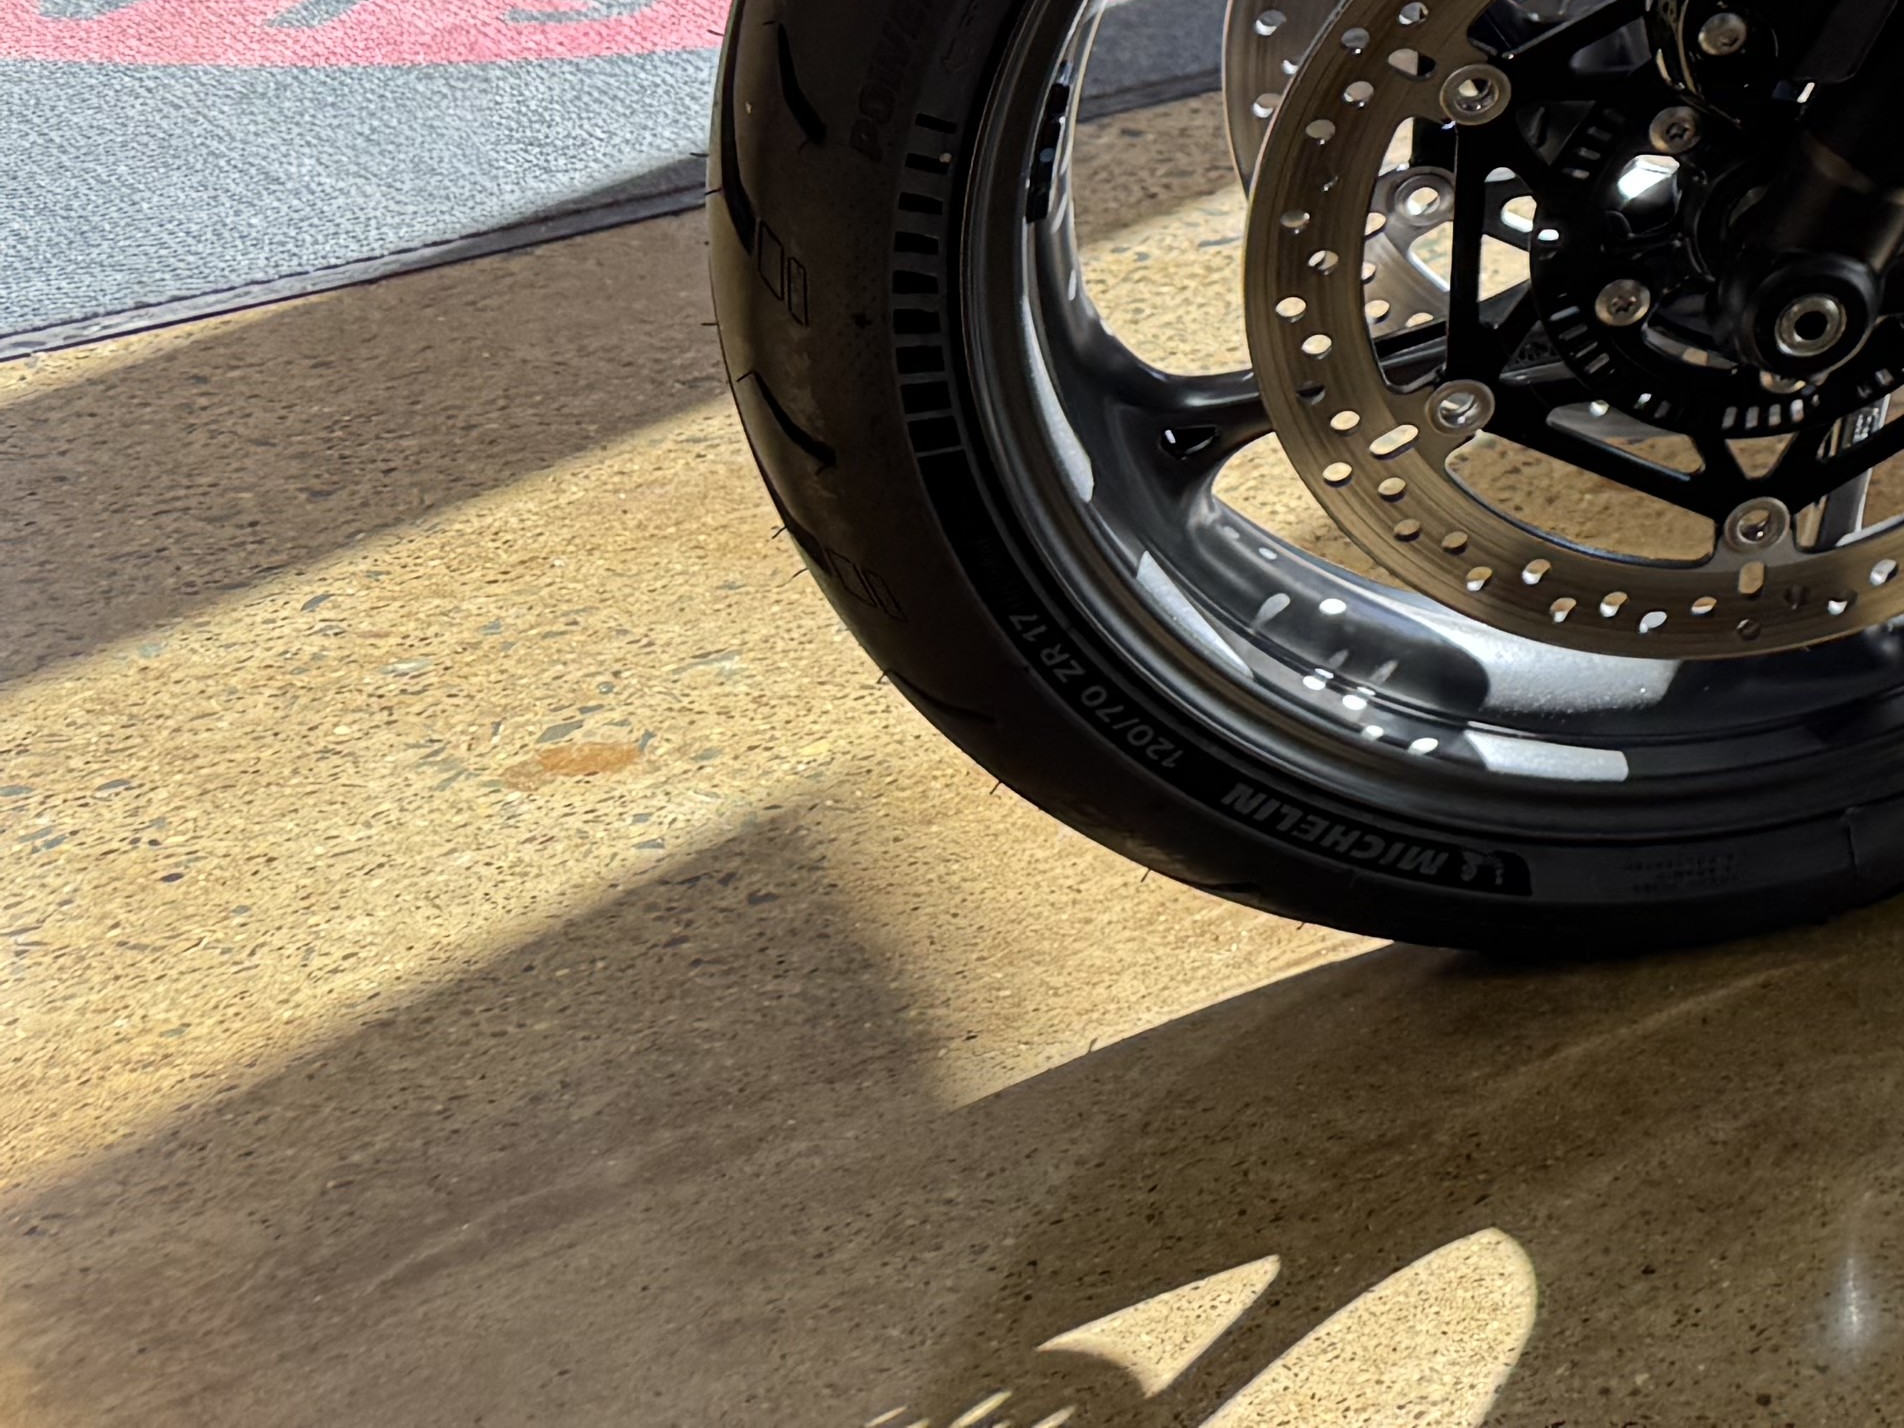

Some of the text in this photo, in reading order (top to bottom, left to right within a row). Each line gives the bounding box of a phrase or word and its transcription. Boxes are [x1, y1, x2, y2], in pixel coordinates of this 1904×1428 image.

[1008, 613, 1450, 876] MICHELIN 120/70 ZR 17
